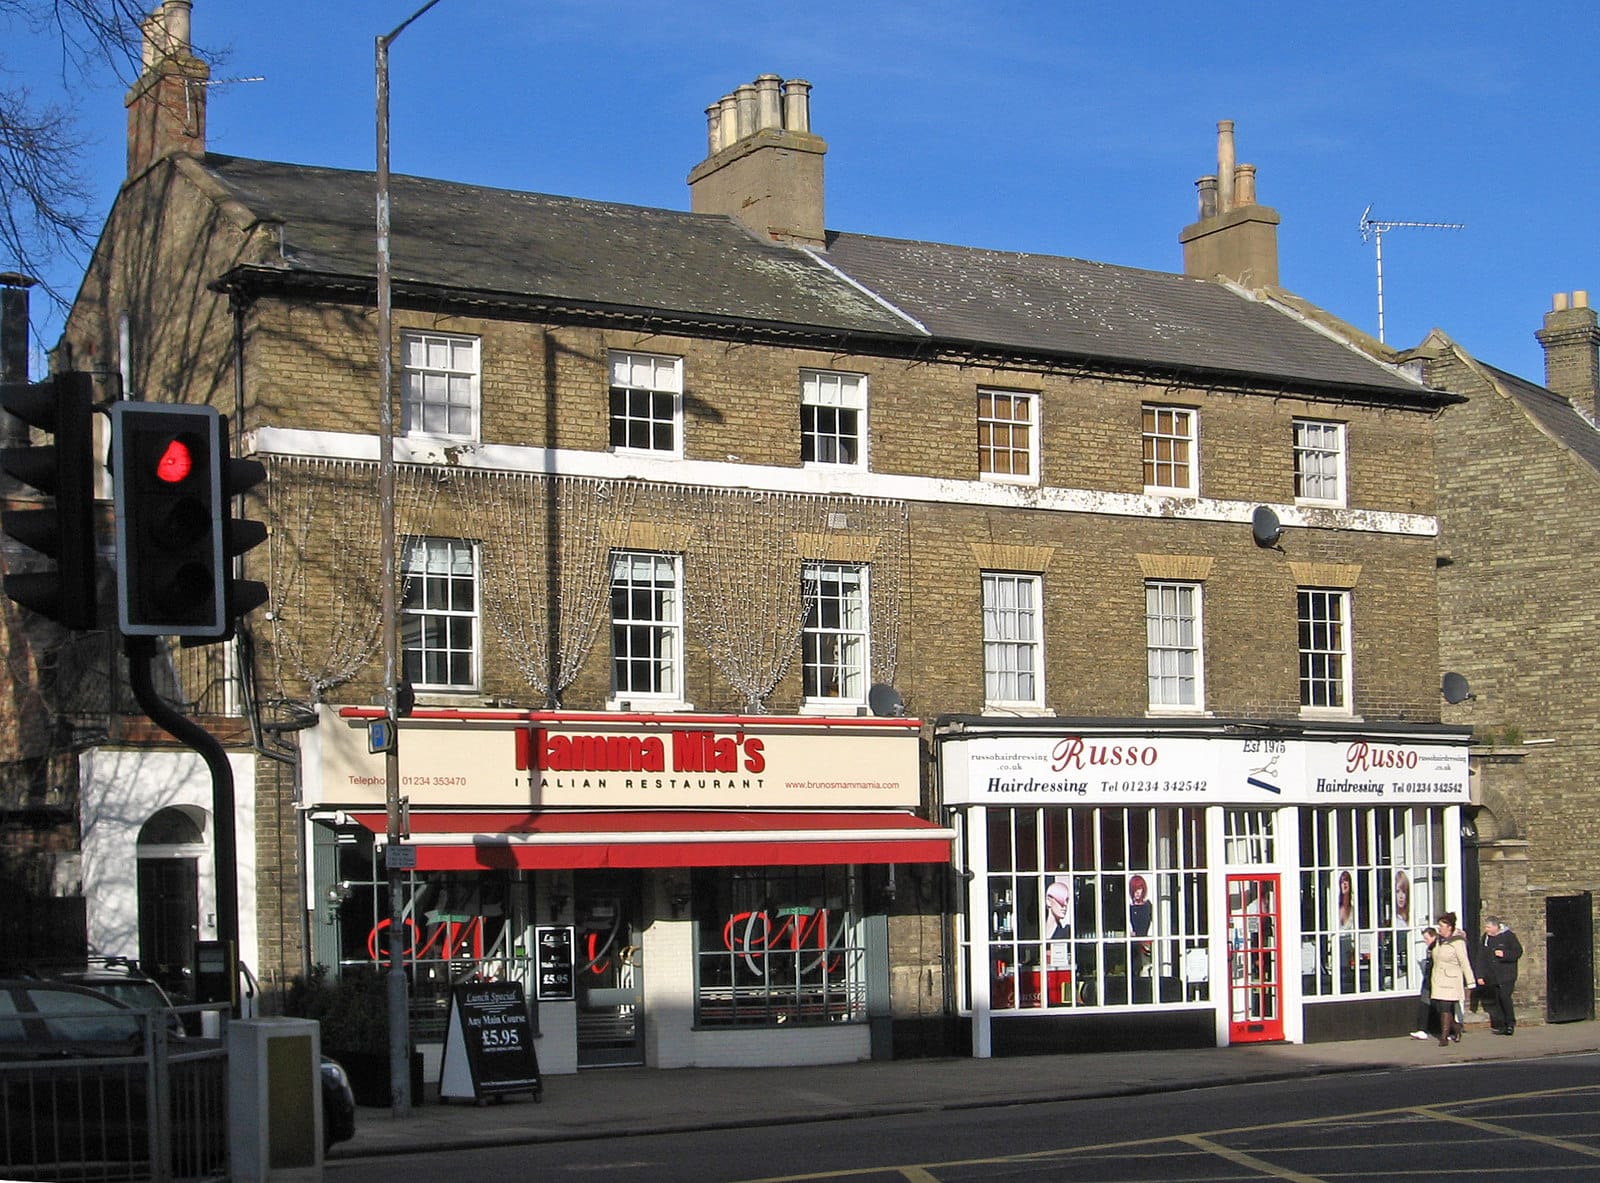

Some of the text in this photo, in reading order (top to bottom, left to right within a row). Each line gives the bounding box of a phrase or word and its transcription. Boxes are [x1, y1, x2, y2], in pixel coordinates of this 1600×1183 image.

[671, 730, 766, 774] Mia's
[971, 753, 1049, 762] russohairdressing
[1051, 736, 1158, 772] Russo
[1346, 740, 1418, 773] Russo
[349, 775, 467, 787] Telepho 01234 353470
[514, 777, 765, 790] ITALIAN RESTAURANT
[785, 780, 900, 790] www.brunosmammamia.com
[987, 777, 1089, 796] Hairdressing
[1101, 780, 1207, 792] Tel 01234 342542
[1316, 778, 1385, 796] Hairdressing
[1392, 783, 1463, 793] Tel 01234 342542
[482, 1015, 501, 1024] Main
[481, 1029, 519, 1046] £5.95
